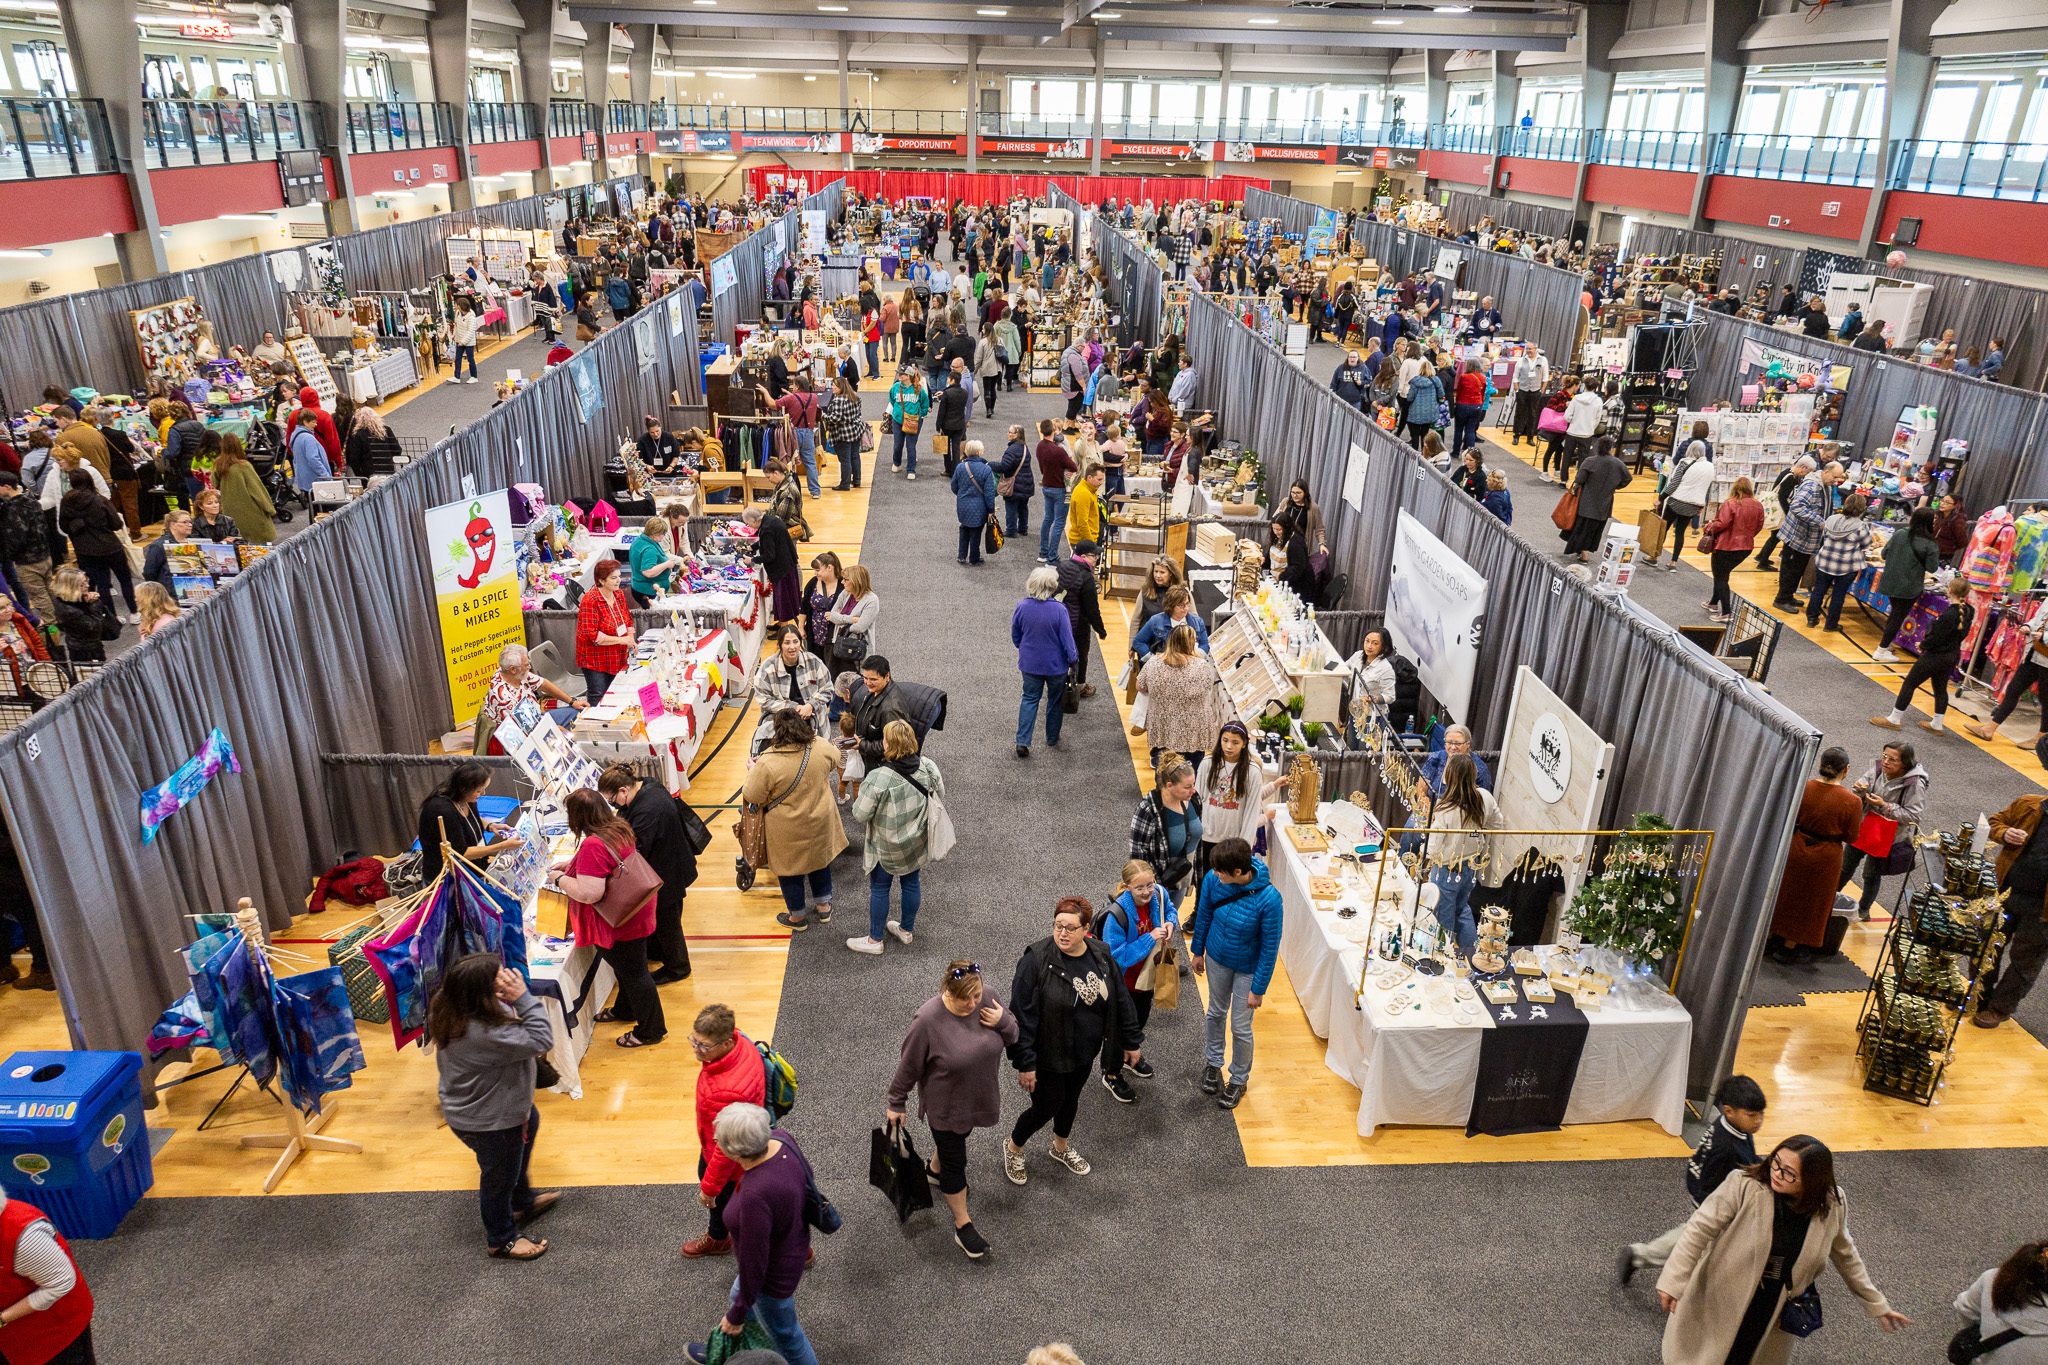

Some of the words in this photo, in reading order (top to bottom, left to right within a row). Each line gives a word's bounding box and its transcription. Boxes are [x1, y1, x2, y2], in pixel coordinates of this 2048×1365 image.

[753, 137, 797, 147] TEAMWORK
[898, 139, 952, 150] OPPORTUNITY
[997, 143, 1036, 152] FAIRNESS
[1122, 145, 1173, 155] EXCELLENCE
[1261, 149, 1319, 159] INCLUSIVENESS
[1796, 360, 1805, 374] in
[1420, 550, 1446, 581] GARDEN
[1445, 572, 1468, 601] SOAPS
[1552, 580, 1562, 595] 84
[453, 605, 460, 616] B
[462, 602, 470, 613] &
[473, 598, 480, 609] D
[482, 589, 509, 606] SPICE
[465, 608, 500, 628] MIXERS
[451, 645, 463, 654] Hot
[464, 637, 487, 650] Pepper
[487, 624, 522, 641] Specialists
[452, 657, 458, 665] &
[460, 648, 484, 662] Custom
[485, 642, 502, 653] Spice
[503, 635, 521, 646] Mixes
[474, 669, 480, 678] A
[480, 662, 500, 675] LITTL
[467, 682, 477, 691] TO
[28, 738, 39, 758] 83
